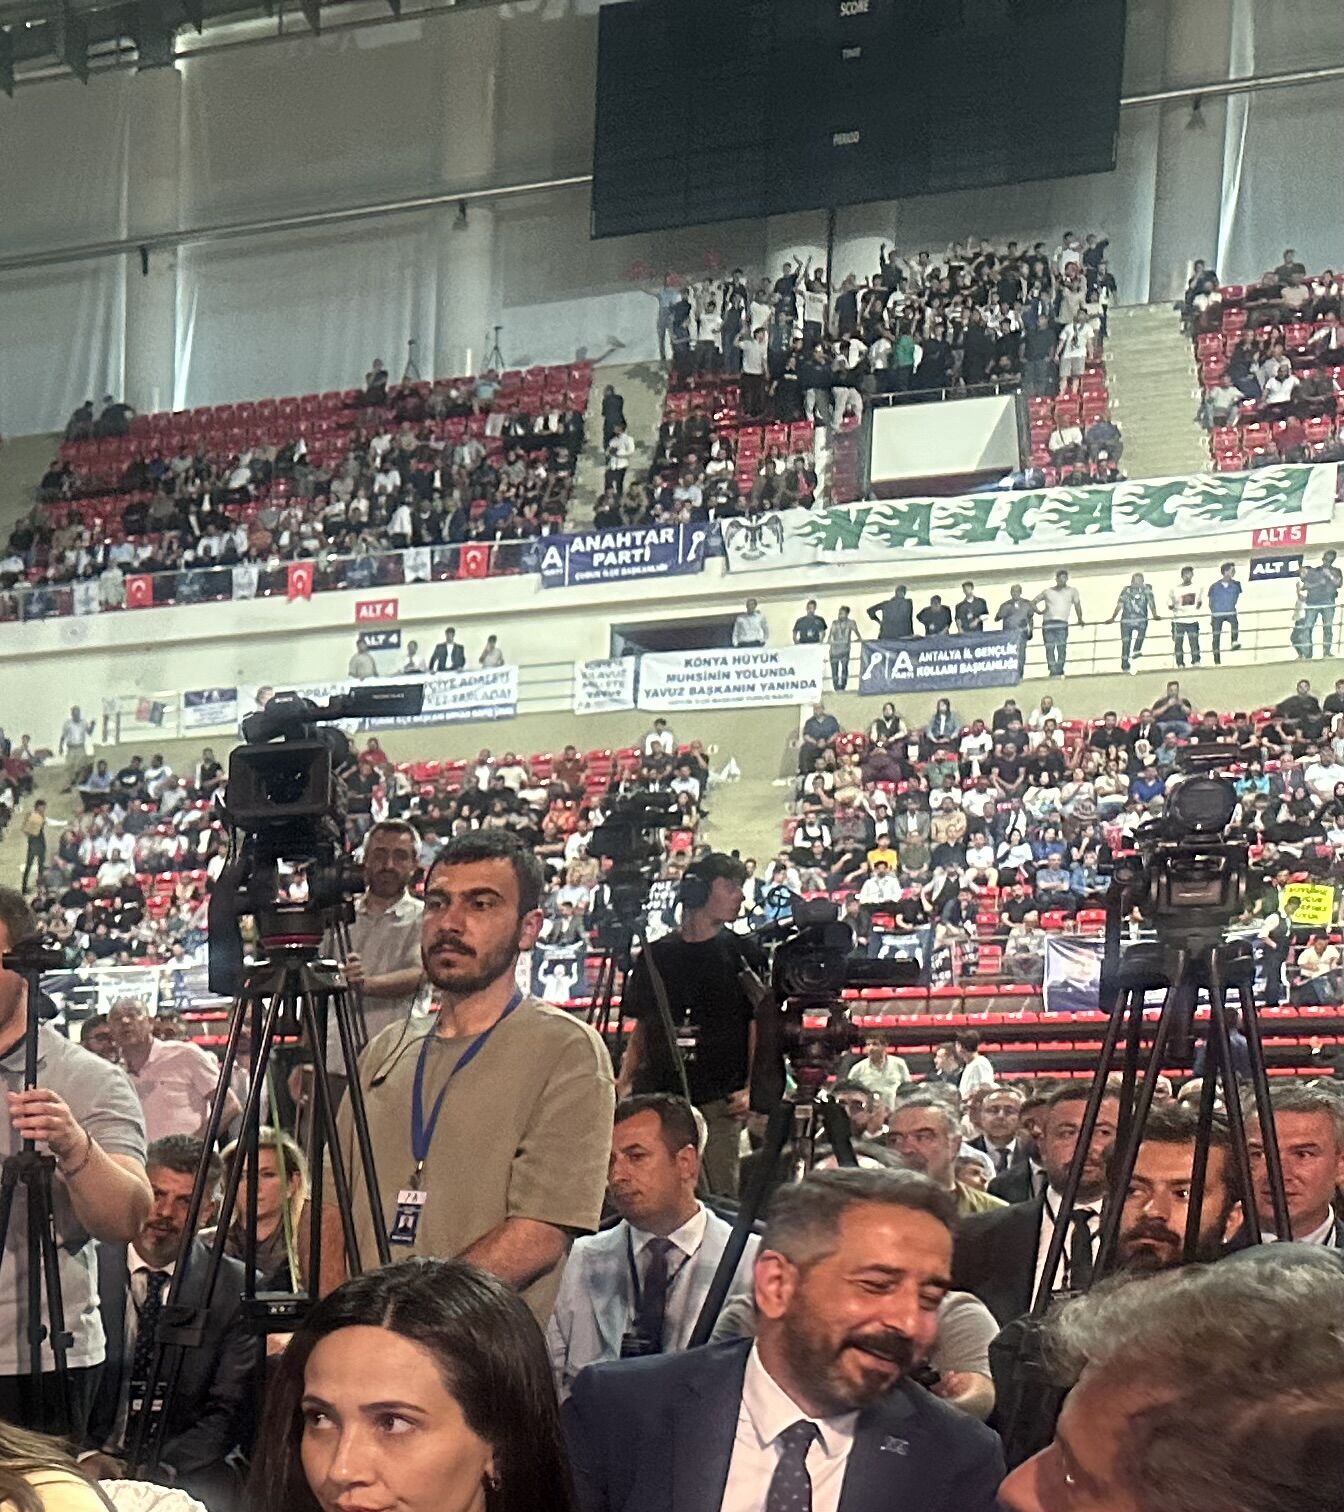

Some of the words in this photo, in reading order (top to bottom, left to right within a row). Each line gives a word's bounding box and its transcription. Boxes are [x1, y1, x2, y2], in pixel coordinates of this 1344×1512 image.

[570, 528, 674, 553] ANAHTAR
[1257, 528, 1287, 544] ALT
[1290, 525, 1301, 540] 5
[593, 545, 651, 567] PARTİ
[1253, 563, 1284, 574] ALT
[359, 604, 382, 619] ALT
[383, 602, 395, 617] 4
[388, 632, 399, 644] 4
[684, 657, 728, 668] KONYA
[732, 653, 779, 665] HÜYÜK
[892, 651, 912, 672] A
[918, 650, 961, 663] ANTALYA
[974, 643, 1018, 660] GENÇLİK
[666, 670, 731, 683] MUHSİNİN
[735, 667, 796, 680] YOLUNDA
[916, 664, 958, 677] KOLLARI
[643, 687, 685, 698] YAVUZ
[689, 683, 756, 697] BAŞKANIN
[760, 679, 817, 692] YANINDA
